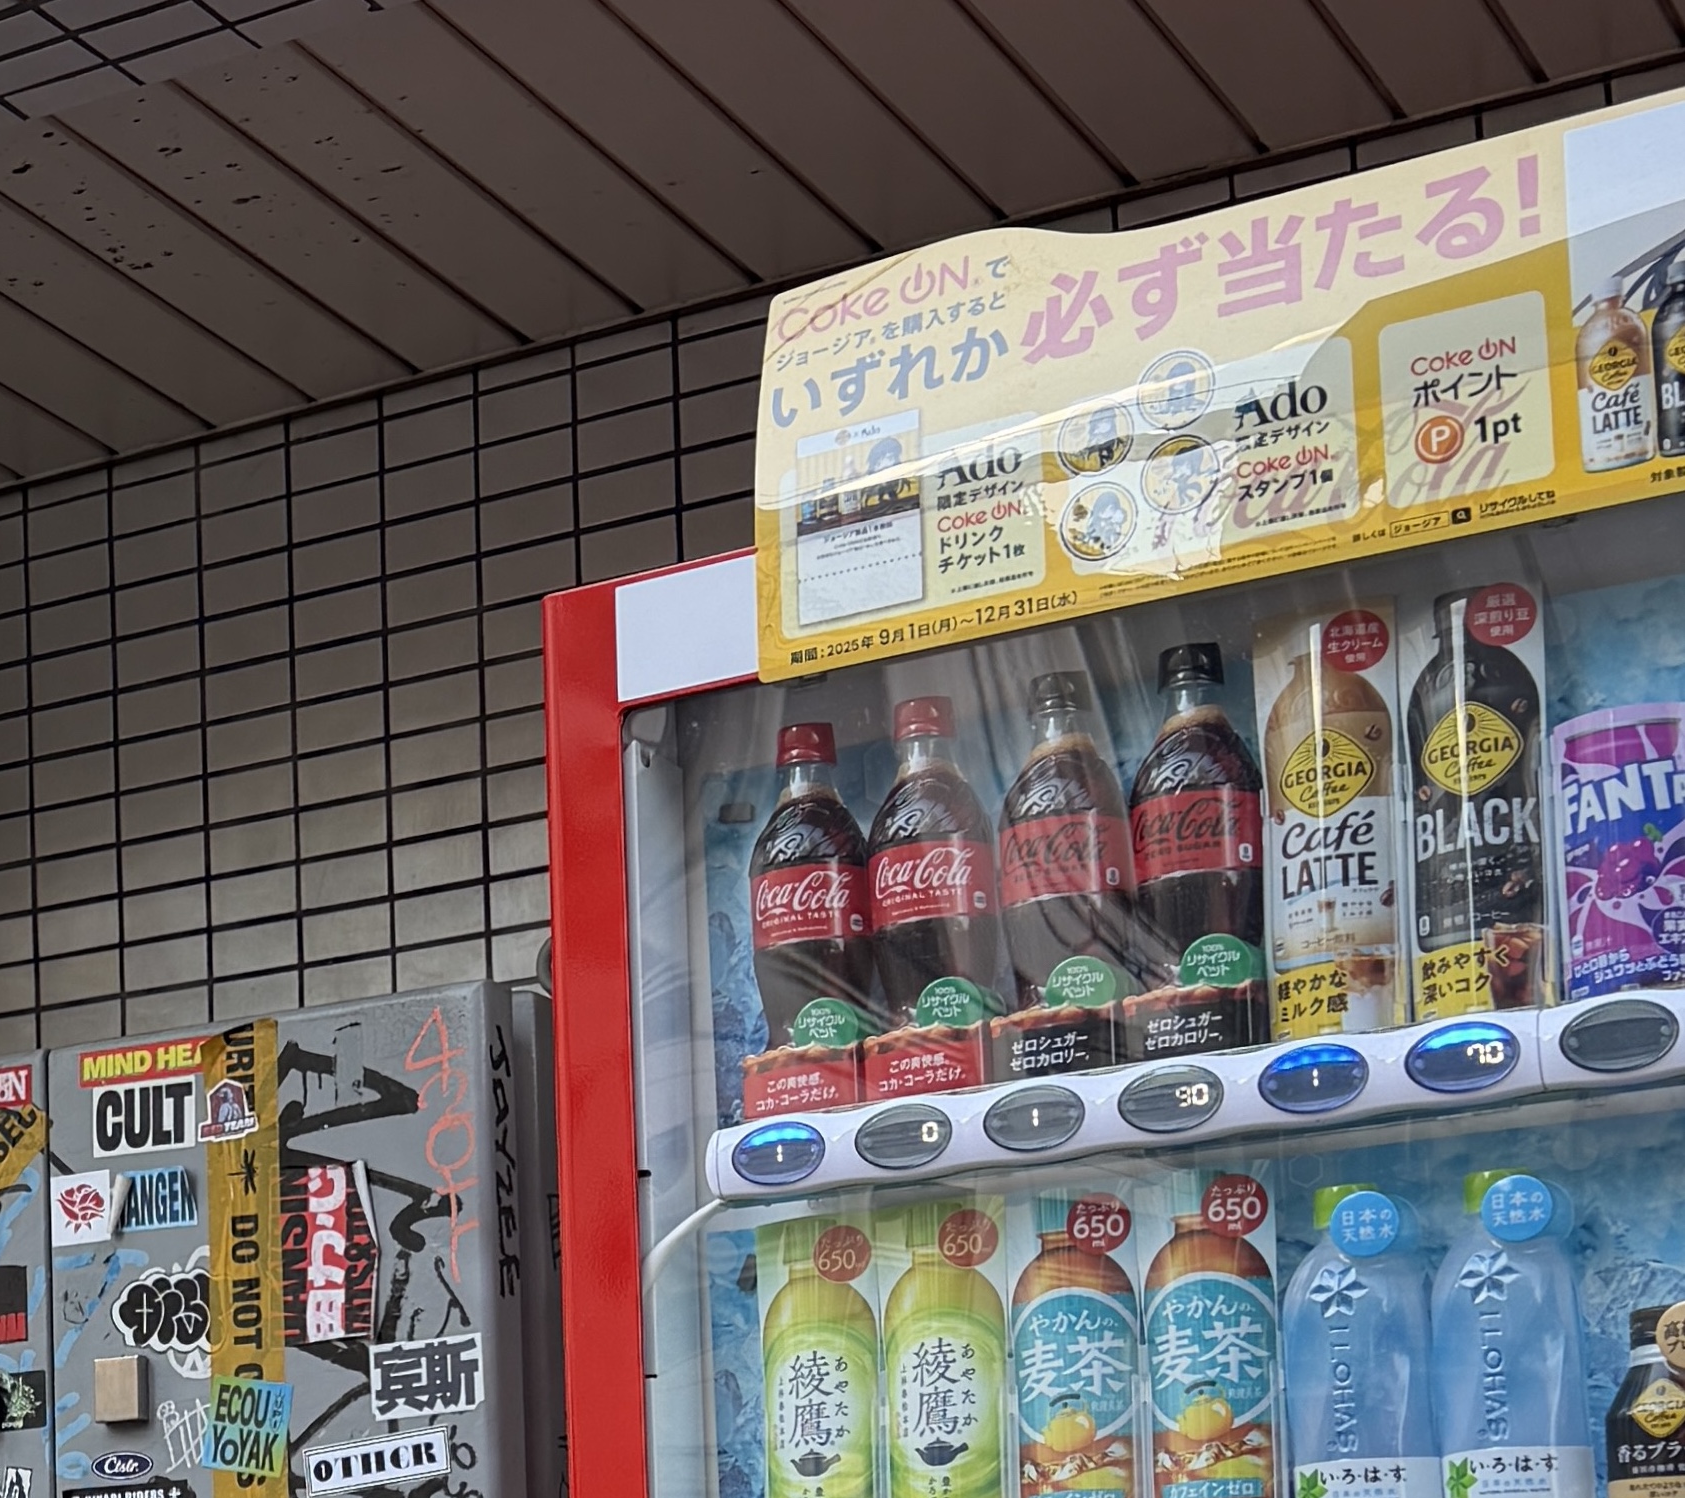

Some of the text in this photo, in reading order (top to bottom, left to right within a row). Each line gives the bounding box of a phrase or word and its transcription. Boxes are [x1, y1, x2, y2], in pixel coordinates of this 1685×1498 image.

[1020, 153, 1542, 366] 必ず当たる!
[778, 288, 890, 343] Coke
[900, 256, 970, 304] ON
[985, 256, 1011, 278] で
[1411, 337, 1515, 376] Coke ON
[771, 327, 1009, 428] いずれか
[1413, 364, 1518, 408] ポイント
[1235, 380, 1328, 432] Ado
[1591, 381, 1640, 409] Café
[1475, 413, 1522, 444] 1pt
[1592, 407, 1643, 435] LATTE
[937, 444, 1023, 490] Ado
[1237, 455, 1291, 479] Coke
[937, 481, 1024, 511] 限定デザイン
[937, 510, 988, 533] Coke
[939, 525, 1004, 554] ドリンク
[938, 544, 1025, 574] チケット1枚
[1427, 737, 1514, 765] GEORGIA
[1284, 761, 1367, 789] GEORGIA
[1135, 798, 1241, 853] Coca-Cola
[1282, 809, 1376, 860] Café
[1415, 797, 1540, 863] BLACK
[875, 847, 975, 900] Coca-Cola
[1282, 851, 1379, 901] LATTE
[756, 870, 853, 922] Coca-Cola
[1187, 950, 1241, 967] リサイクル
[1421, 946, 1509, 976] 飲みやすく
[1052, 972, 1104, 988] リサイクル
[1277, 969, 1347, 1003] 軽やかな
[1422, 972, 1492, 1005] 深いコク
[922, 993, 970, 1008] リサイクル
[1281, 993, 1349, 1023] ミルク感
[798, 1014, 845, 1029] リサイクル
[1148, 1011, 1223, 1033] ゼロシュガー
[1012, 1032, 1088, 1055] ゼロシュガー
[83, 1050, 152, 1081] MIND
[96, 1082, 193, 1152] CULT
[1208, 1200, 1261, 1221] 650
[1490, 1190, 1544, 1209] 日本の
[1073, 1216, 1124, 1237] 650
[1341, 1209, 1392, 1227] 日本の
[1493, 1207, 1547, 1228] 天然水
[229, 1214, 260, 1266] DO
[1341, 1224, 1395, 1244] 天然水
[232, 1274, 264, 1350] NOT
[1019, 1331, 1133, 1404] 麦茶
[1152, 1316, 1271, 1390] 麦茶
[789, 1350, 834, 1449] 綾鷹
[834, 1356, 850, 1439] あやたか
[912, 1338, 960, 1437] 綾鷹
[961, 1343, 978, 1427] あやたか
